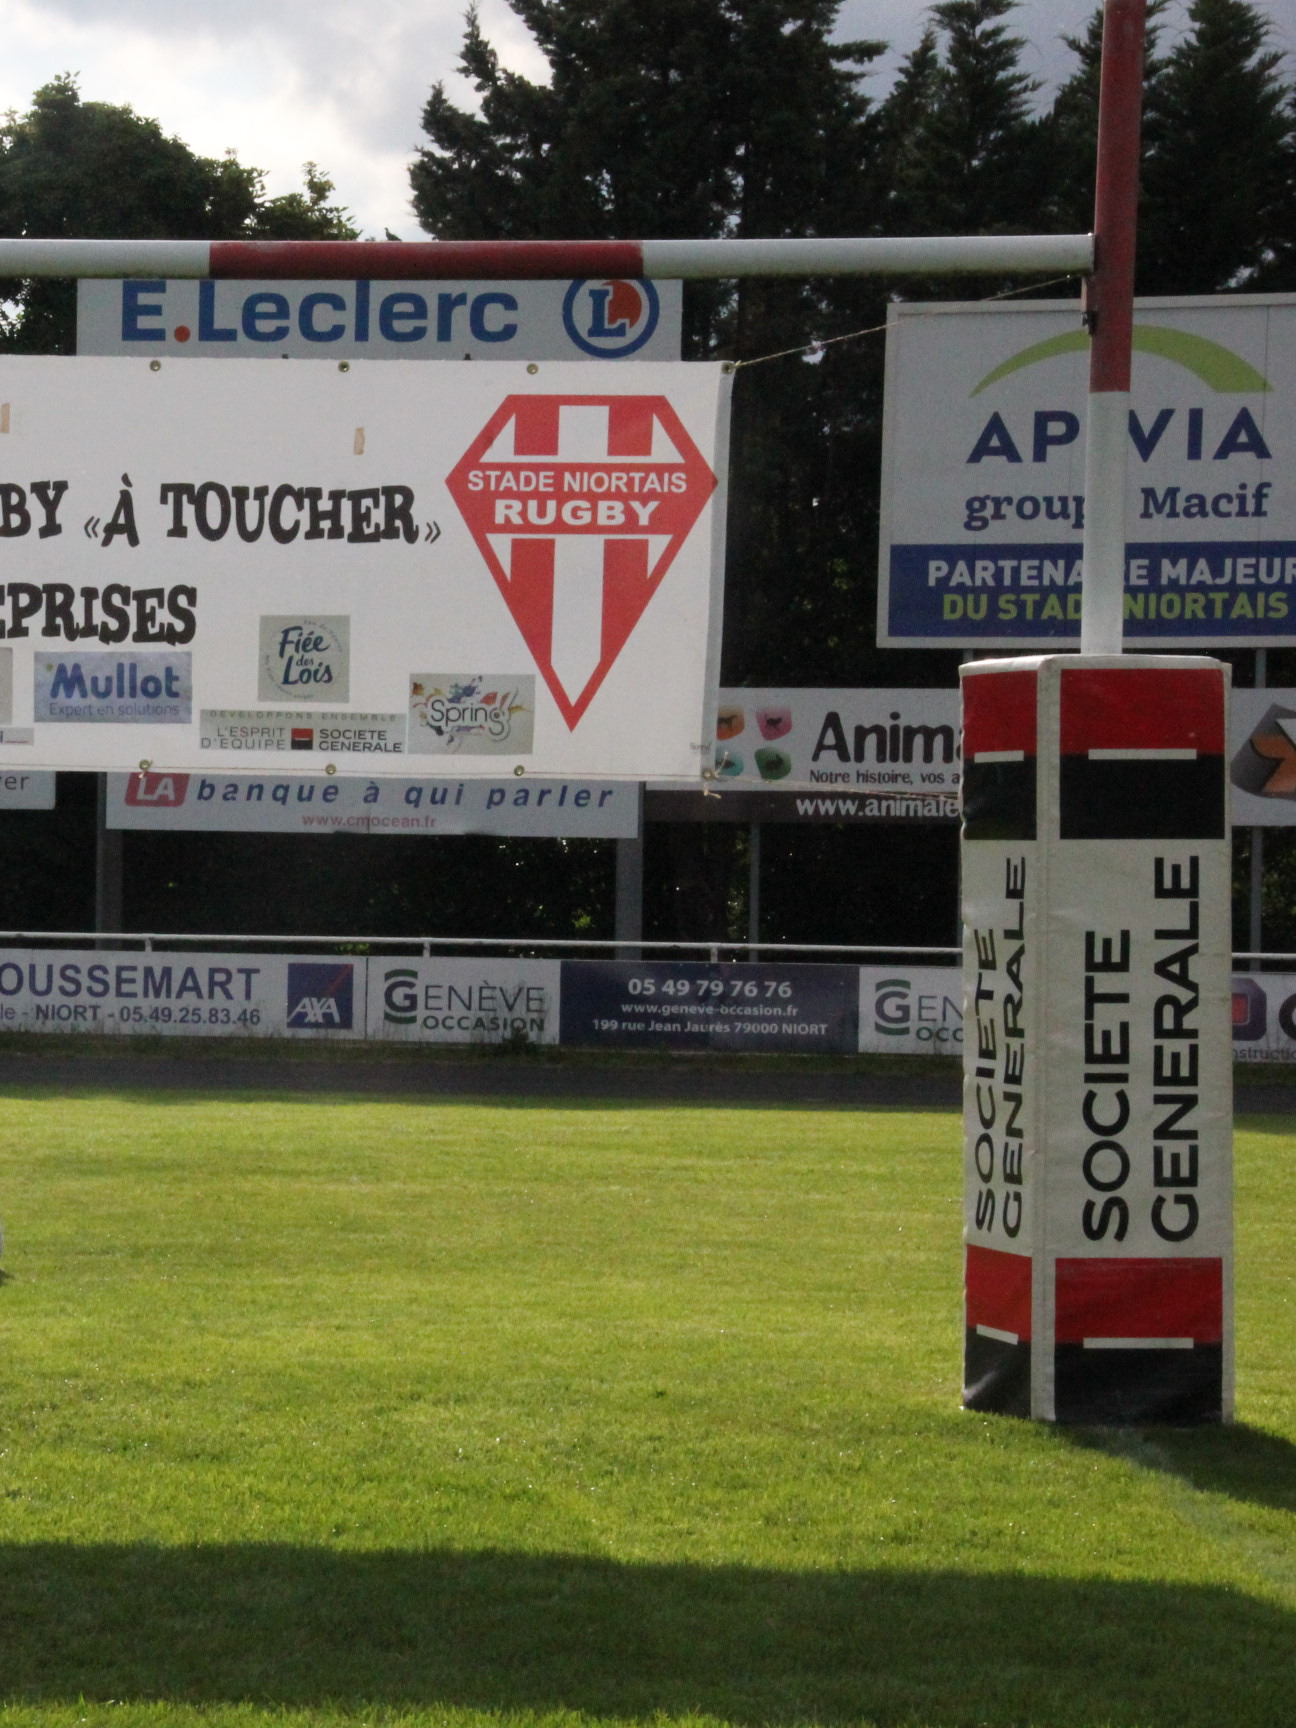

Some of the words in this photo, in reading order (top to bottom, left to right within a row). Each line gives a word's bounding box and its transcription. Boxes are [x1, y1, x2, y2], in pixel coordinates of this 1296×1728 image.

[121, 280, 519, 342] E.Leclerc
[966, 407, 1273, 464] APVIA
[468, 470, 554, 492] STADE
[563, 471, 687, 493] NIORTAIS
[494, 499, 661, 526] RUGBY
[1140, 482, 1273, 519] Macif
[928, 559, 1149, 587] PARTENAE
[943, 593, 987, 620] DU
[998, 593, 1082, 620] STAD
[1124, 592, 1289, 620] NIORTAIS
[279, 626, 331, 659] Fiée
[281, 655, 333, 685] Lois
[296, 654, 314, 666] des
[50, 663, 180, 699] Mullot
[49, 702, 93, 718] Expert
[97, 705, 114, 716] en
[118, 702, 180, 717] solutions
[431, 700, 506, 735] Spring
[201, 738, 286, 750] D'EQUIPE
[217, 727, 286, 738] L'ESPRIT
[319, 729, 387, 740] SOCIETE
[319, 741, 403, 753] GENERALE
[810, 769, 850, 784] Notre
[856, 770, 914, 785] histoire,
[920, 773, 945, 784] vos
[136, 776, 176, 801] LA
[197, 779, 339, 805] banque
[363, 781, 380, 804] à
[405, 783, 464, 808] qui
[487, 785, 613, 809] parler
[302, 814, 436, 829] www.cmocean.fr
[628, 978, 655, 996] 05
[661, 979, 690, 996] 49
[696, 979, 724, 997] 79
[730, 980, 758, 997] 76
[764, 980, 792, 998] 76
[36, 1004, 101, 1021] NIORT
[120, 1005, 261, 1025] 05.49.25.83.46
[287, 997, 341, 1024] AXA
[423, 1015, 544, 1032] OCCASION
[592, 1019, 618, 1030] 199
[621, 1021, 645, 1031] rue
[648, 1020, 681, 1032] Jean
[684, 1020, 731, 1033] Jaurès
[734, 1022, 779, 1034] 79000
[782, 1023, 827, 1035] NIORT
[1004, 856, 1026, 1238] GENERALE
[1151, 855, 1199, 1242] GENERALE
[974, 928, 997, 1232] SOCIETE
[1082, 929, 1130, 1242] SOCIETE
